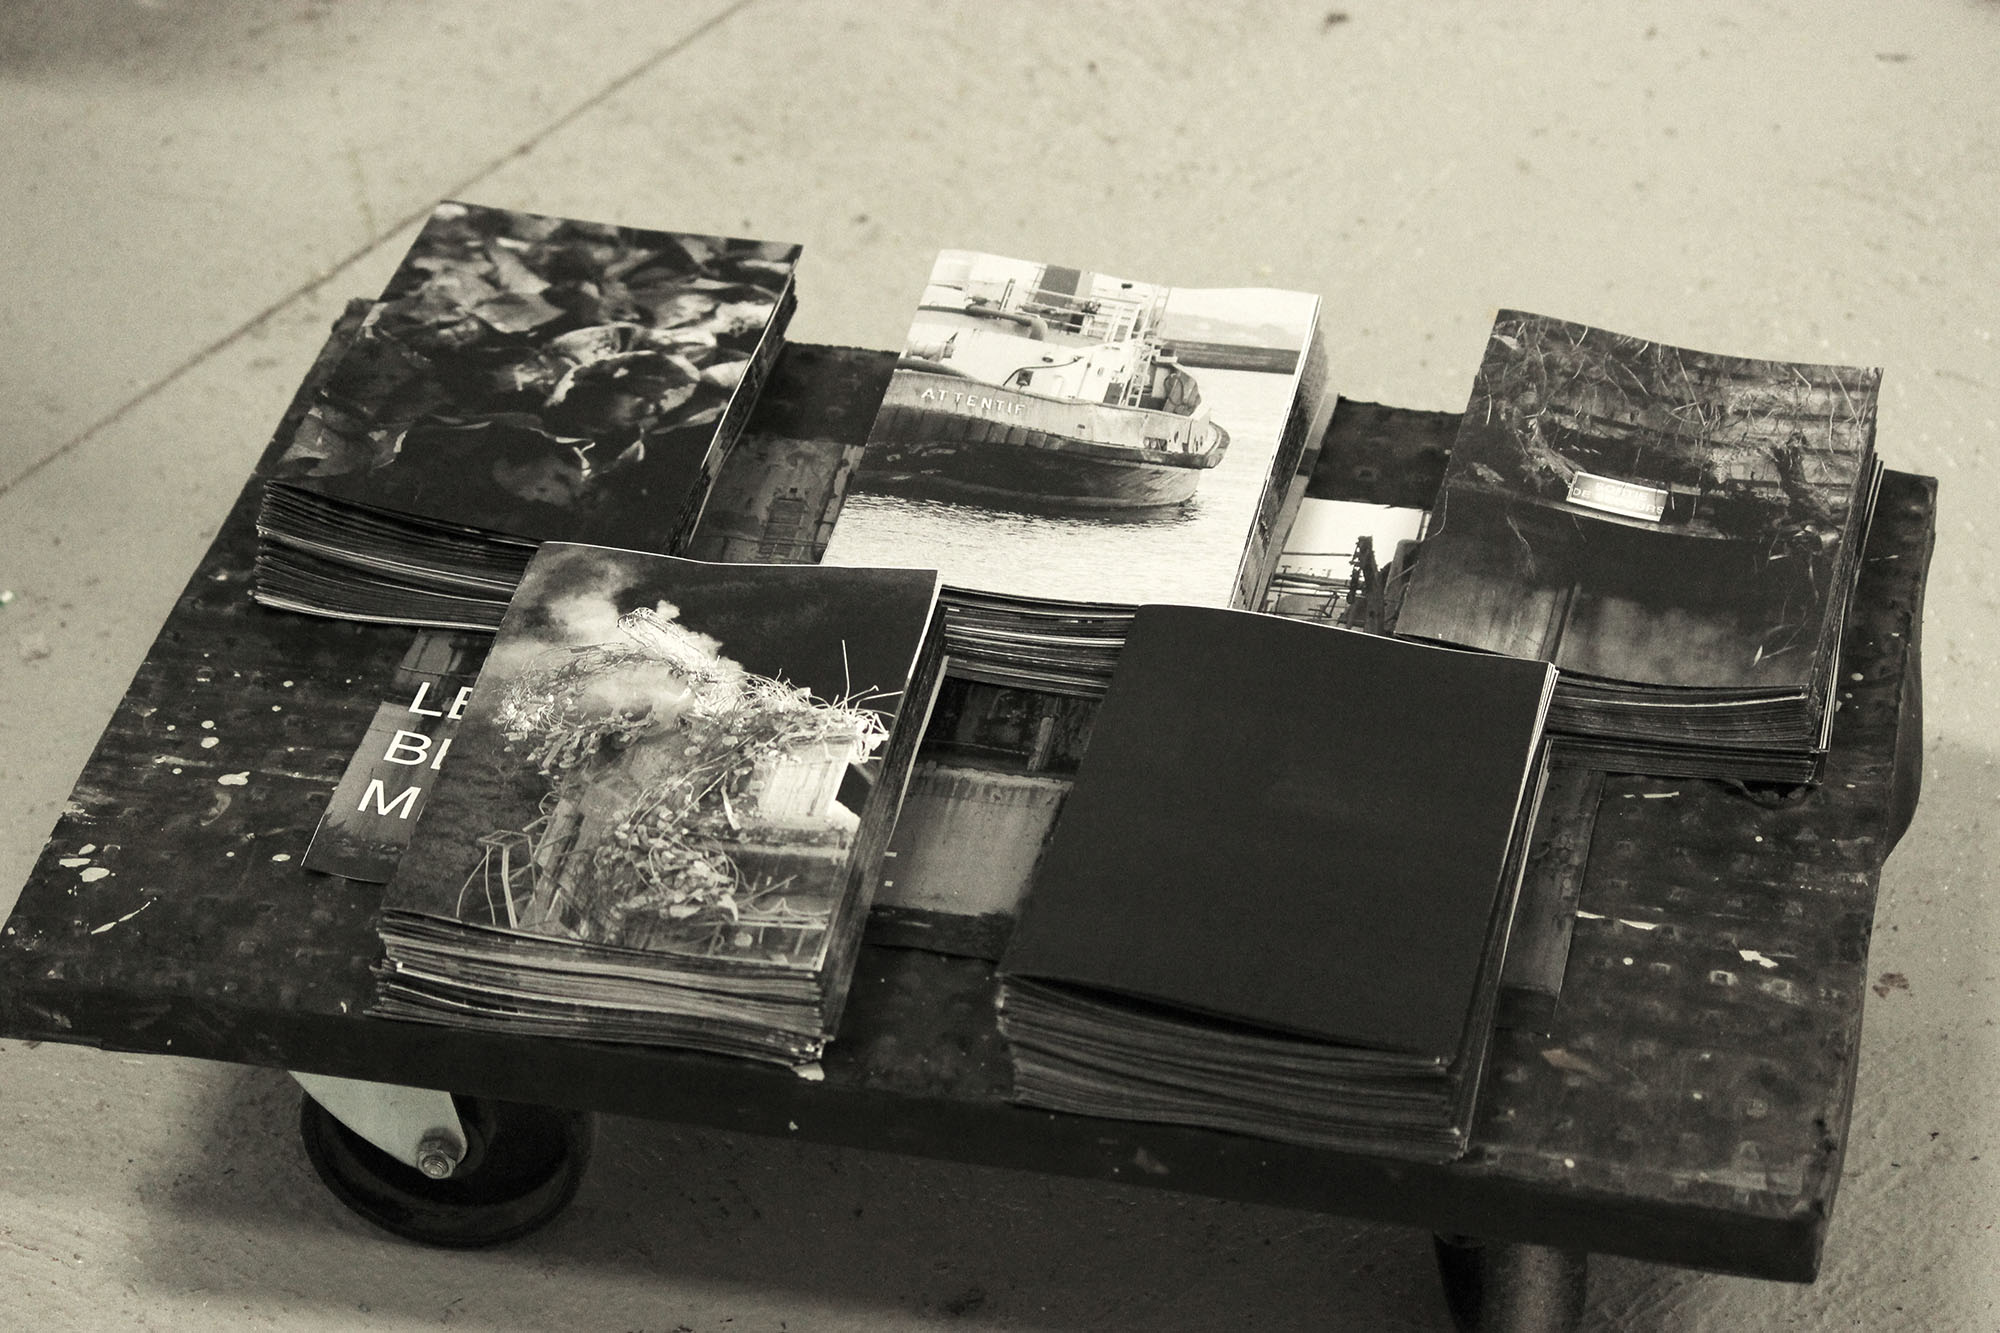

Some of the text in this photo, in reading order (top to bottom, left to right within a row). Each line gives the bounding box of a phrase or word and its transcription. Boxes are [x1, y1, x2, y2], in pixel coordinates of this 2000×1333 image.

[921, 388, 1025, 415] ATTENTIF
[1573, 487, 1592, 499] DE
[357, 778, 422, 820] M
